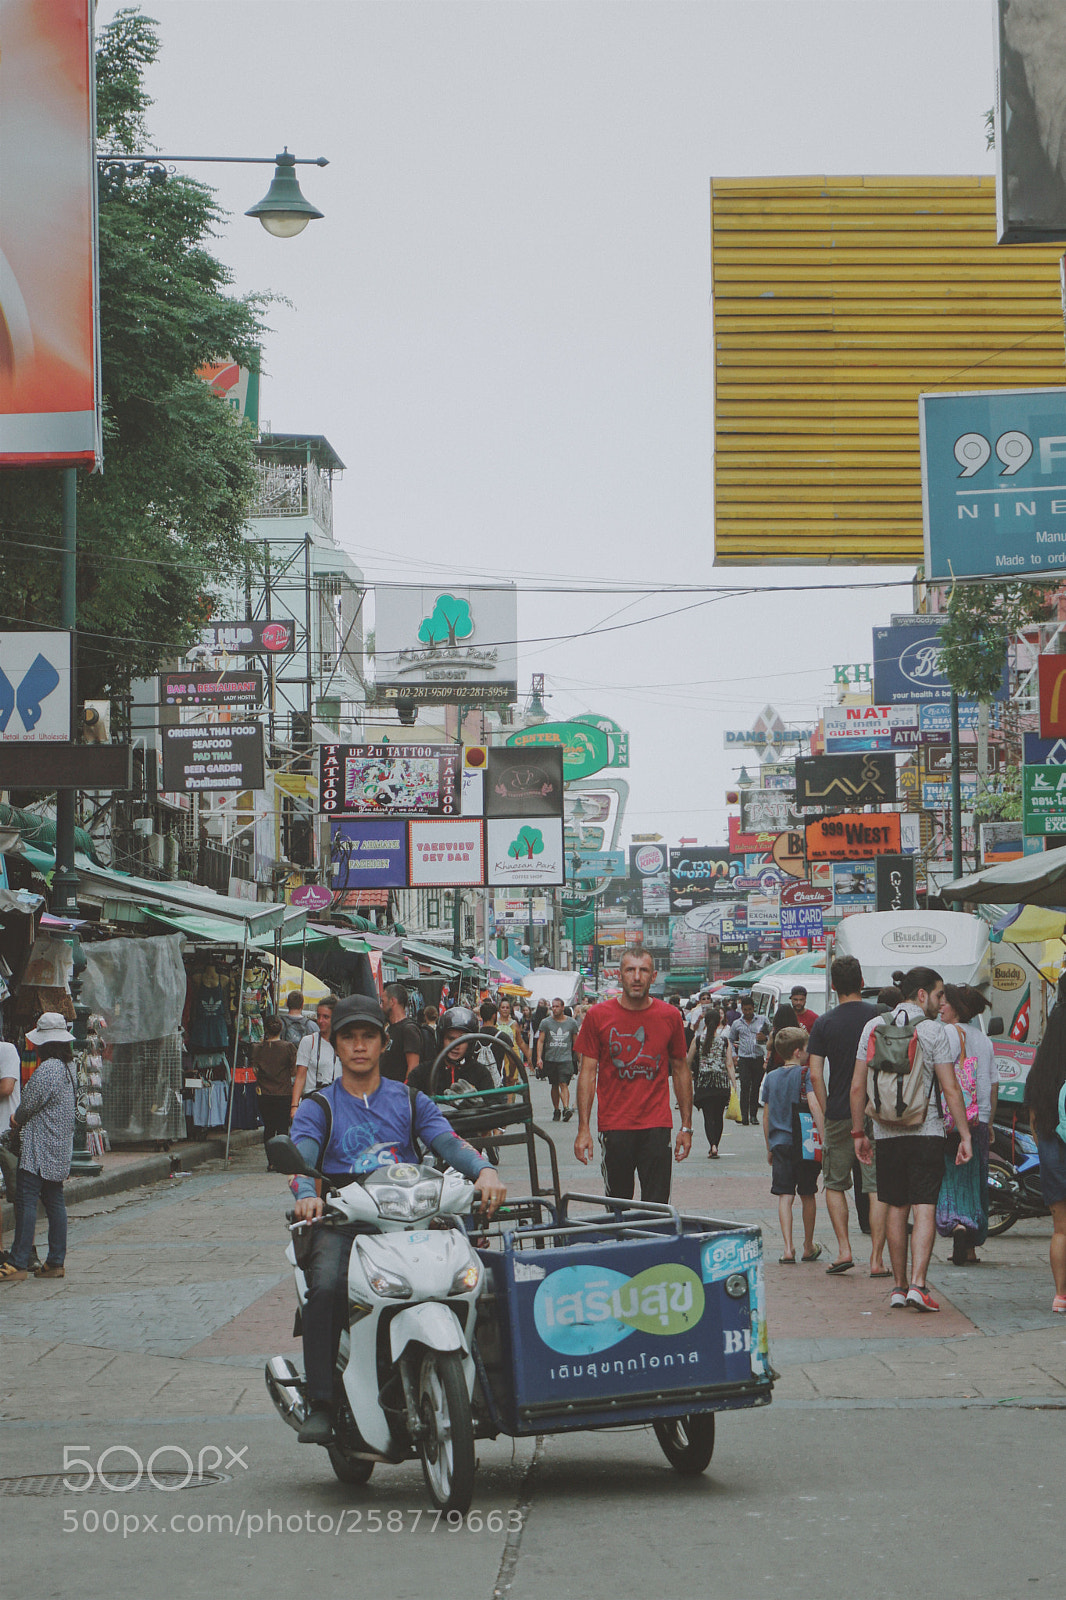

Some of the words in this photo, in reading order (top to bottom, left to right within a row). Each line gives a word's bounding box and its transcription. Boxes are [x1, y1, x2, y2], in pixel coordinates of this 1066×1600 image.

[995, 554, 1025, 566] Made
[1031, 553, 1041, 564] to
[218, 627, 253, 643] HUB
[167, 684, 186, 694] BAR
[187, 683, 196, 693] &
[197, 681, 257, 693] RESTAURANT
[892, 692, 909, 700] your
[910, 690, 933, 698] health
[846, 706, 891, 720] NAT
[2, 732, 20, 740] Retail
[23, 732, 35, 740] and
[38, 732, 68, 740] Wholesale
[167, 728, 209, 738] ORIGINAL
[209, 726, 230, 736] THAI
[231, 726, 256, 735] FOOD
[726, 731, 767, 742] DANG
[829, 729, 868, 737] GUEST
[894, 730, 922, 743] ATM
[192, 739, 232, 749] SEAFOOD
[514, 732, 561, 746] CENTER
[349, 747, 363, 756] UP
[386, 746, 432, 757] TATTOO
[616, 733, 628, 765] INN
[193, 752, 210, 761] PAD
[211, 751, 232, 760] THAI
[184, 765, 205, 774] BEER
[206, 763, 243, 773] GARDEN
[323, 745, 340, 810] TATTOO
[442, 756, 456, 814] TATTOO
[821, 822, 844, 837] 999
[845, 822, 891, 844] WEST
[360, 839, 400, 850] ARMANI
[422, 853, 444, 862] SKY
[638, 851, 660, 862] BURGER
[640, 855, 661, 868] KING
[494, 860, 533, 871] Khaosan
[535, 861, 557, 870] Park
[794, 891, 826, 902] Charlie
[781, 909, 796, 925] SIM
[798, 908, 822, 923] CARD
[782, 929, 800, 938] UNLOCK
[807, 928, 823, 936] PHONE
[893, 931, 937, 943] Buddy
[994, 967, 1021, 979] Buddy
[544, 1280, 693, 1326] เสริมสุข
[550, 1351, 699, 1380] เติมสุขทุกโอกาส
